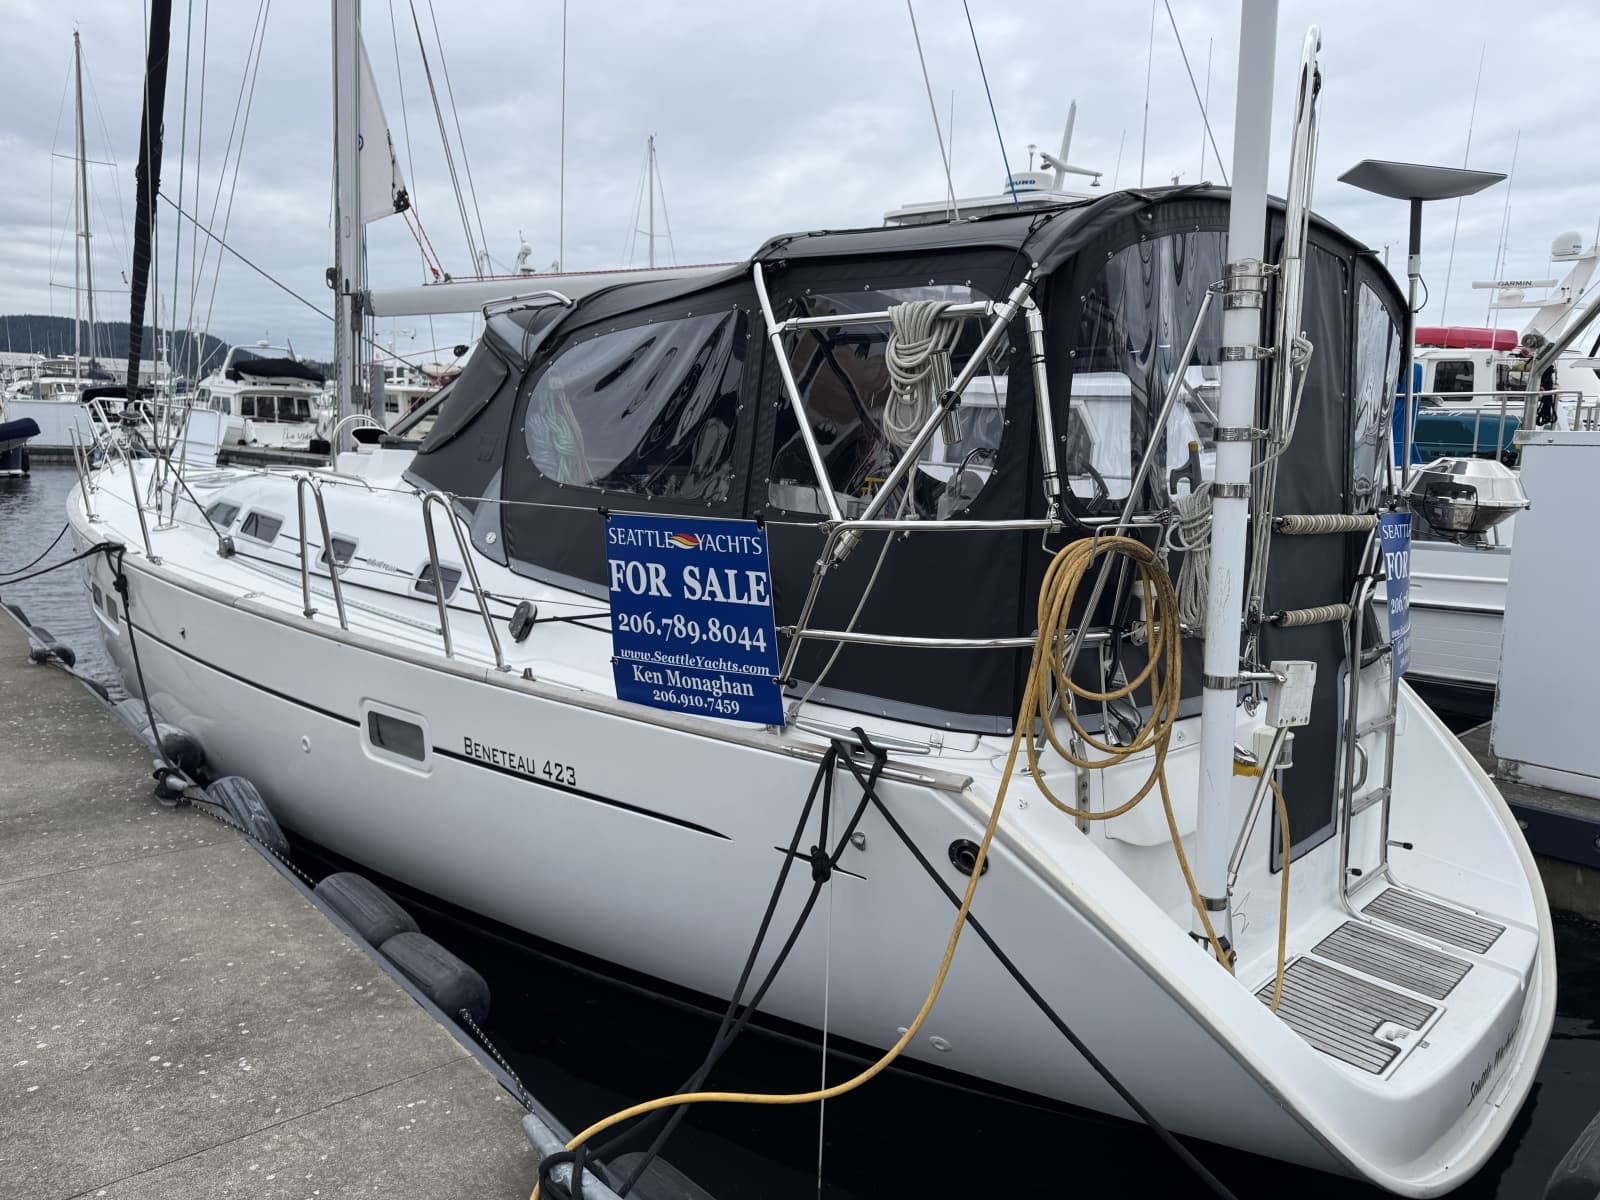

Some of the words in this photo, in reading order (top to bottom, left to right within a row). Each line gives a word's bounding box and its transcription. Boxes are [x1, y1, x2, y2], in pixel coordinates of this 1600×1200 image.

[608, 527, 674, 549] SEATTLE
[694, 533, 763, 555] YACHTS
[1385, 551, 1408, 581] FOR
[608, 559, 672, 598] FOR
[683, 565, 770, 607] SALE
[618, 611, 767, 652] 206.789.8044
[620, 648, 770, 676] www.SeattleYachts.com
[632, 664, 663, 685] Ken
[665, 669, 754, 697] Monaghan
[653, 689, 740, 715] 206.910.7459
[542, 760, 576, 786] 423
